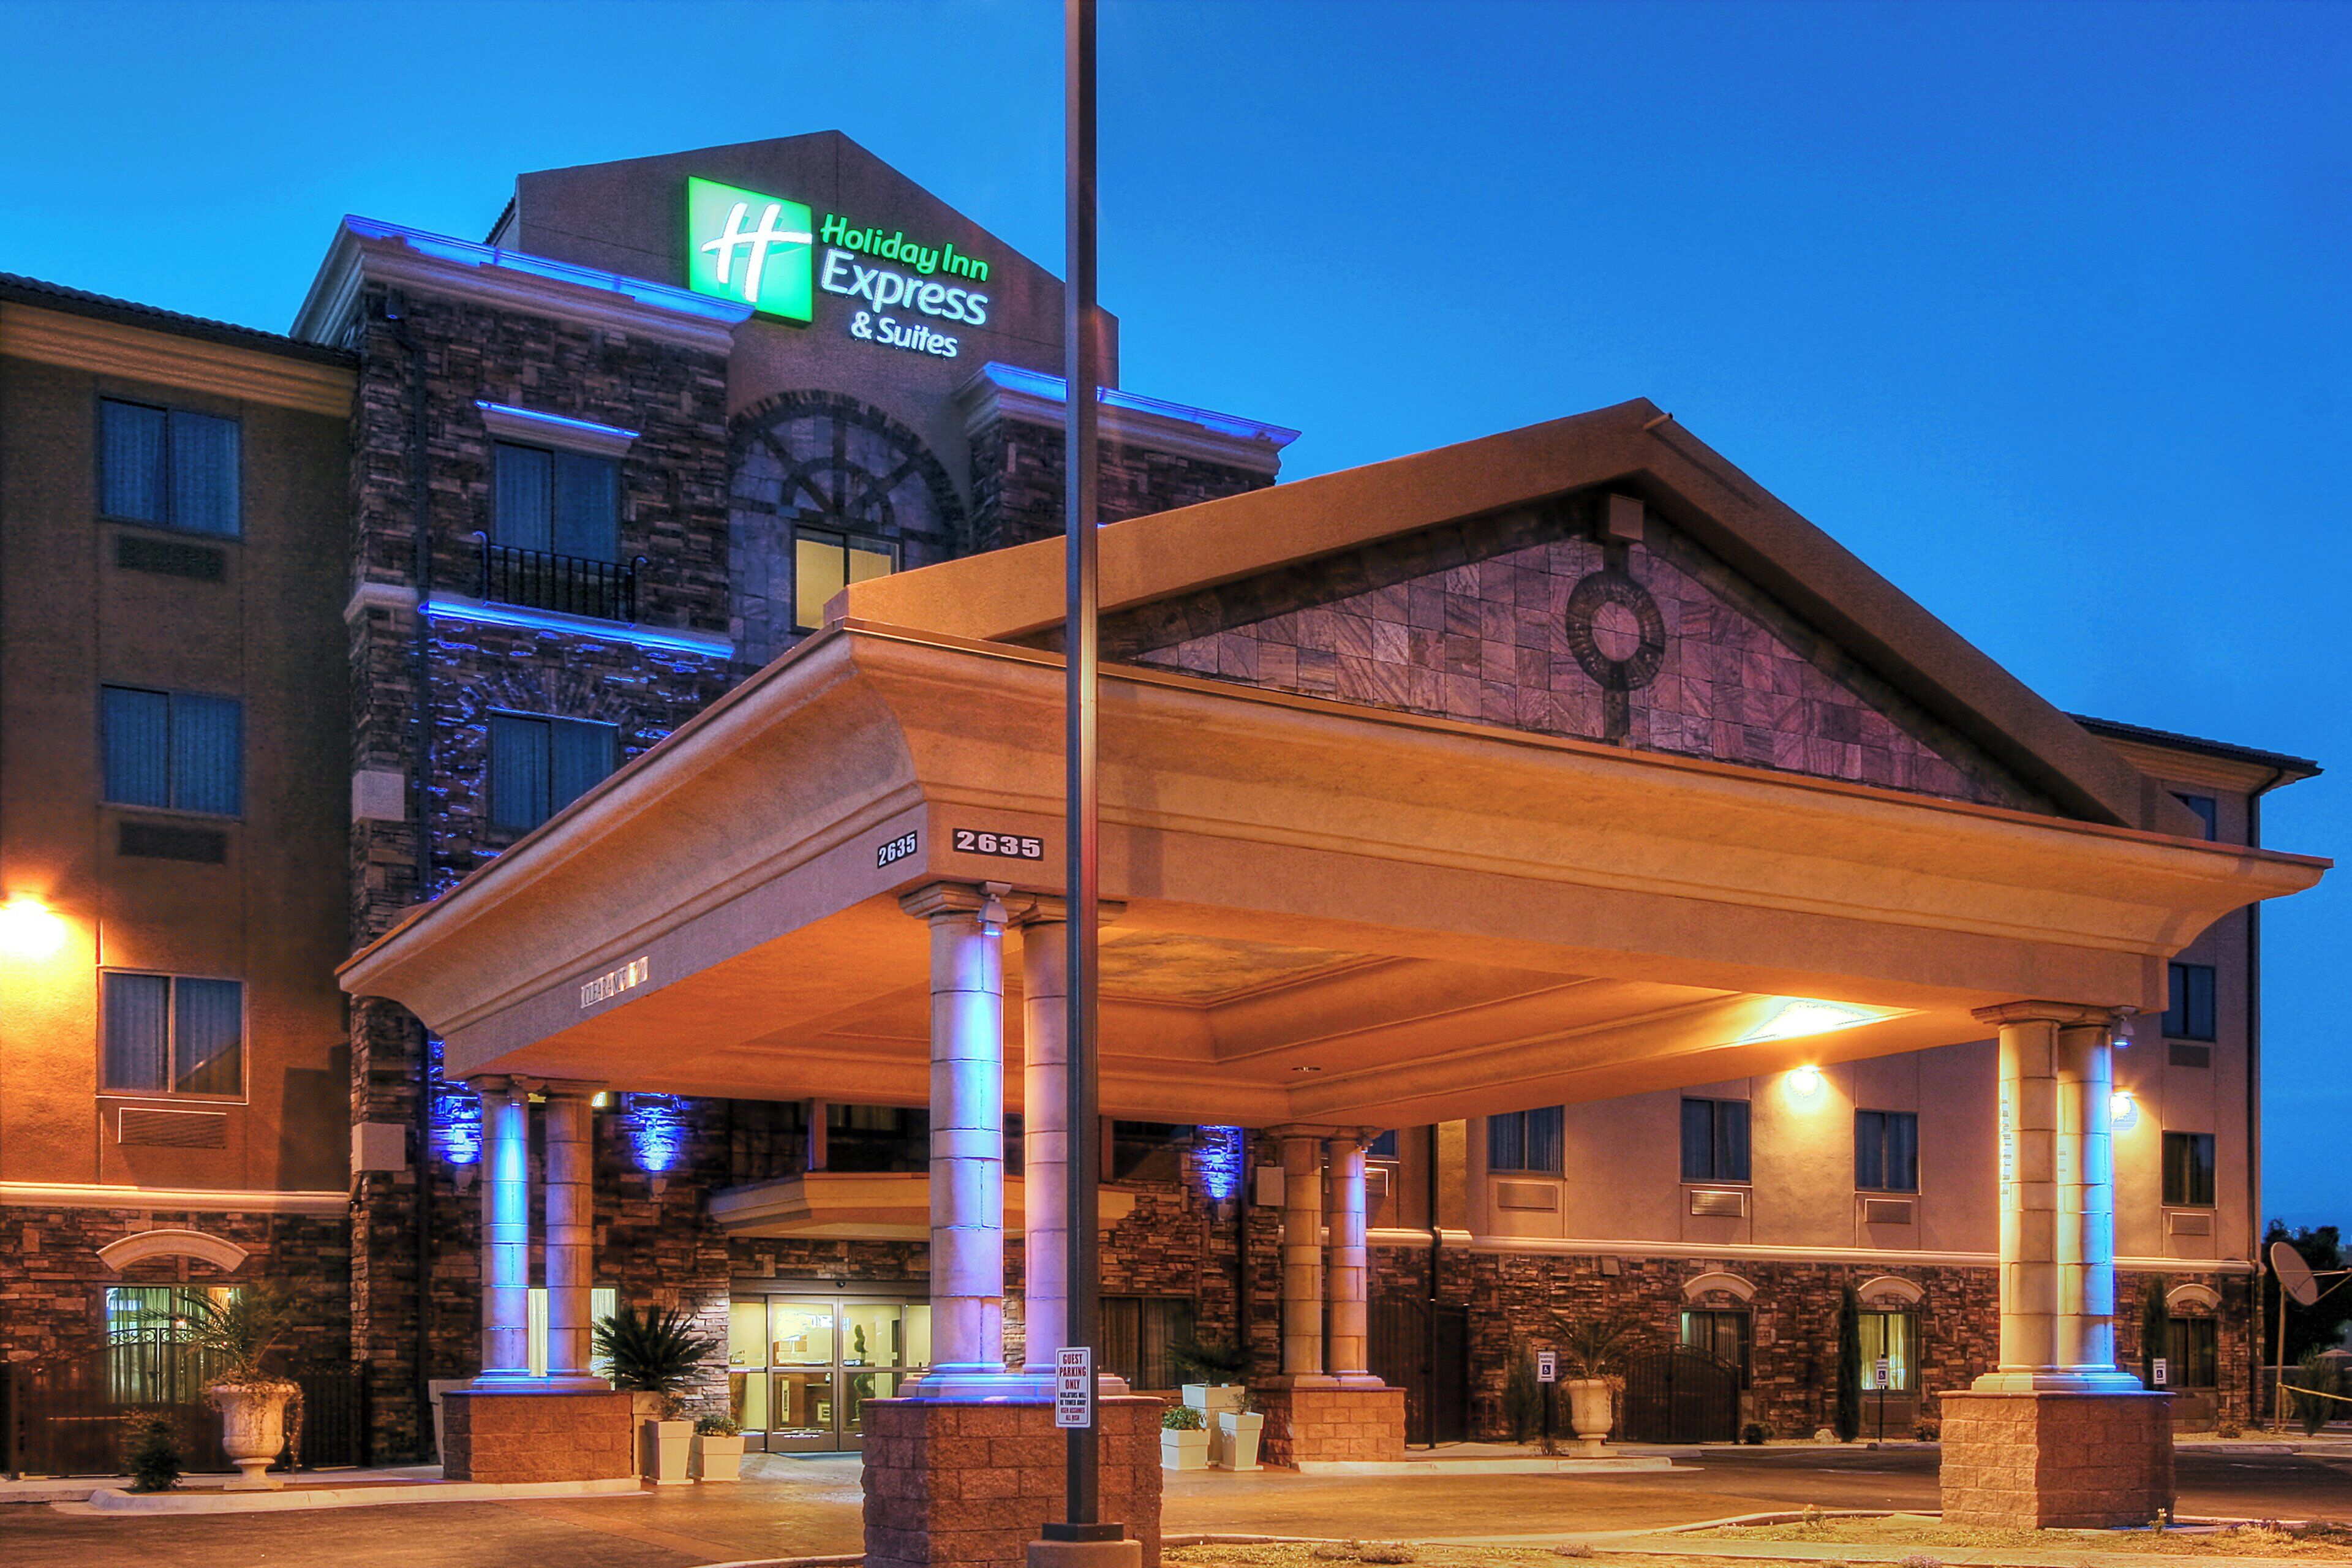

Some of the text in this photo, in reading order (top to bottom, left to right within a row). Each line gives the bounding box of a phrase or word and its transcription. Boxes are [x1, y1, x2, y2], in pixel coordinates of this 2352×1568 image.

[820, 213, 989, 282] Holiday Inn
[821, 248, 989, 325] Express
[851, 311, 958, 358] & Suites
[878, 834, 916, 866] 2635
[957, 831, 1041, 858] 2635
[1059, 1366, 1087, 1378] PARKING
[1063, 1354, 1083, 1365] GUEST
[1065, 1379, 1080, 1390] ONLY
